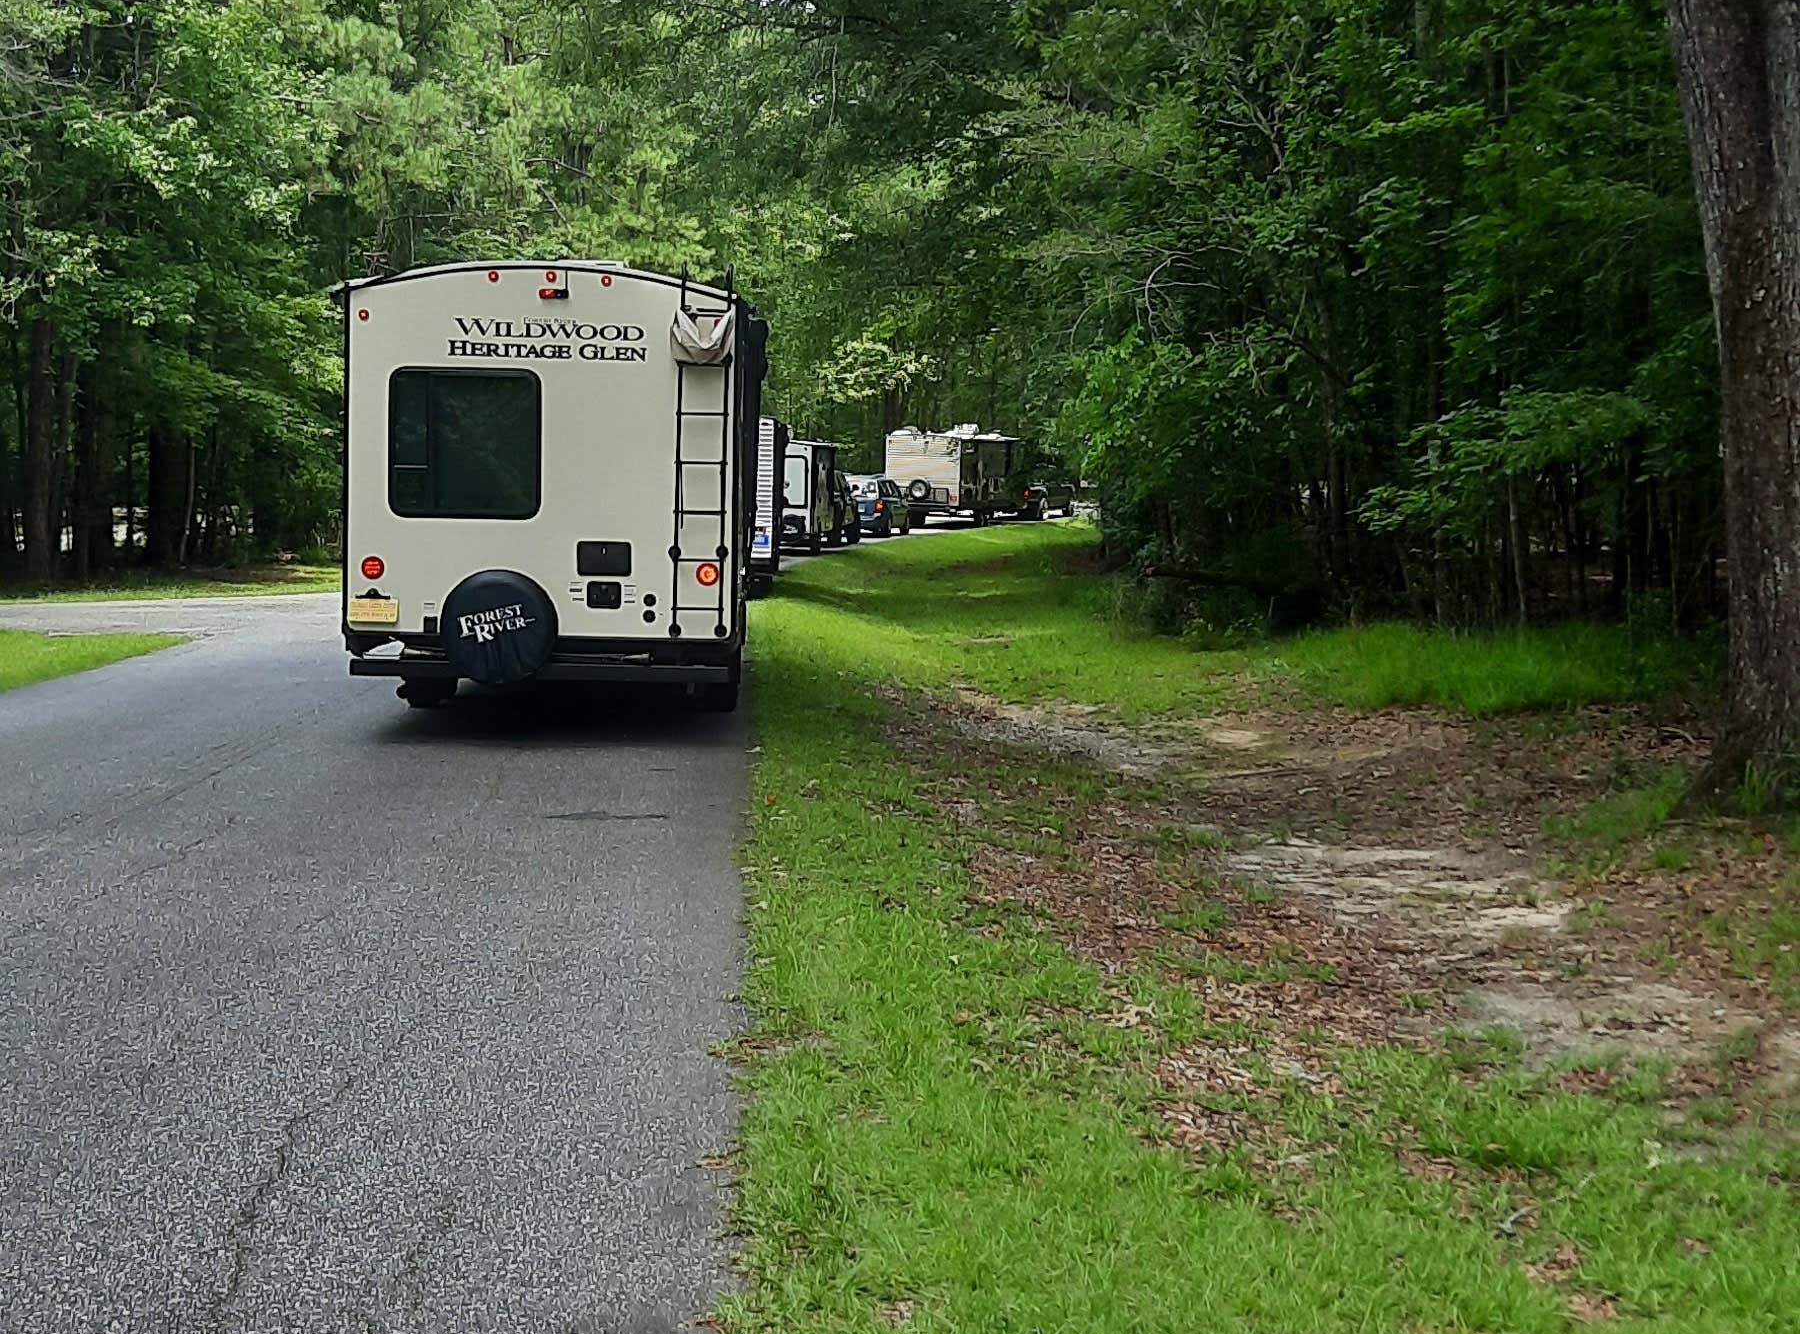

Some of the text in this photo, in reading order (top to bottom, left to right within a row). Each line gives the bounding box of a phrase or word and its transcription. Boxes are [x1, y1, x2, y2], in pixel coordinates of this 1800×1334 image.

[454, 317, 645, 341] WILDWOOD
[448, 339, 647, 361] HERITAGE GLEN
[457, 604, 522, 638] FOREST
[474, 617, 535, 643] RIVER
